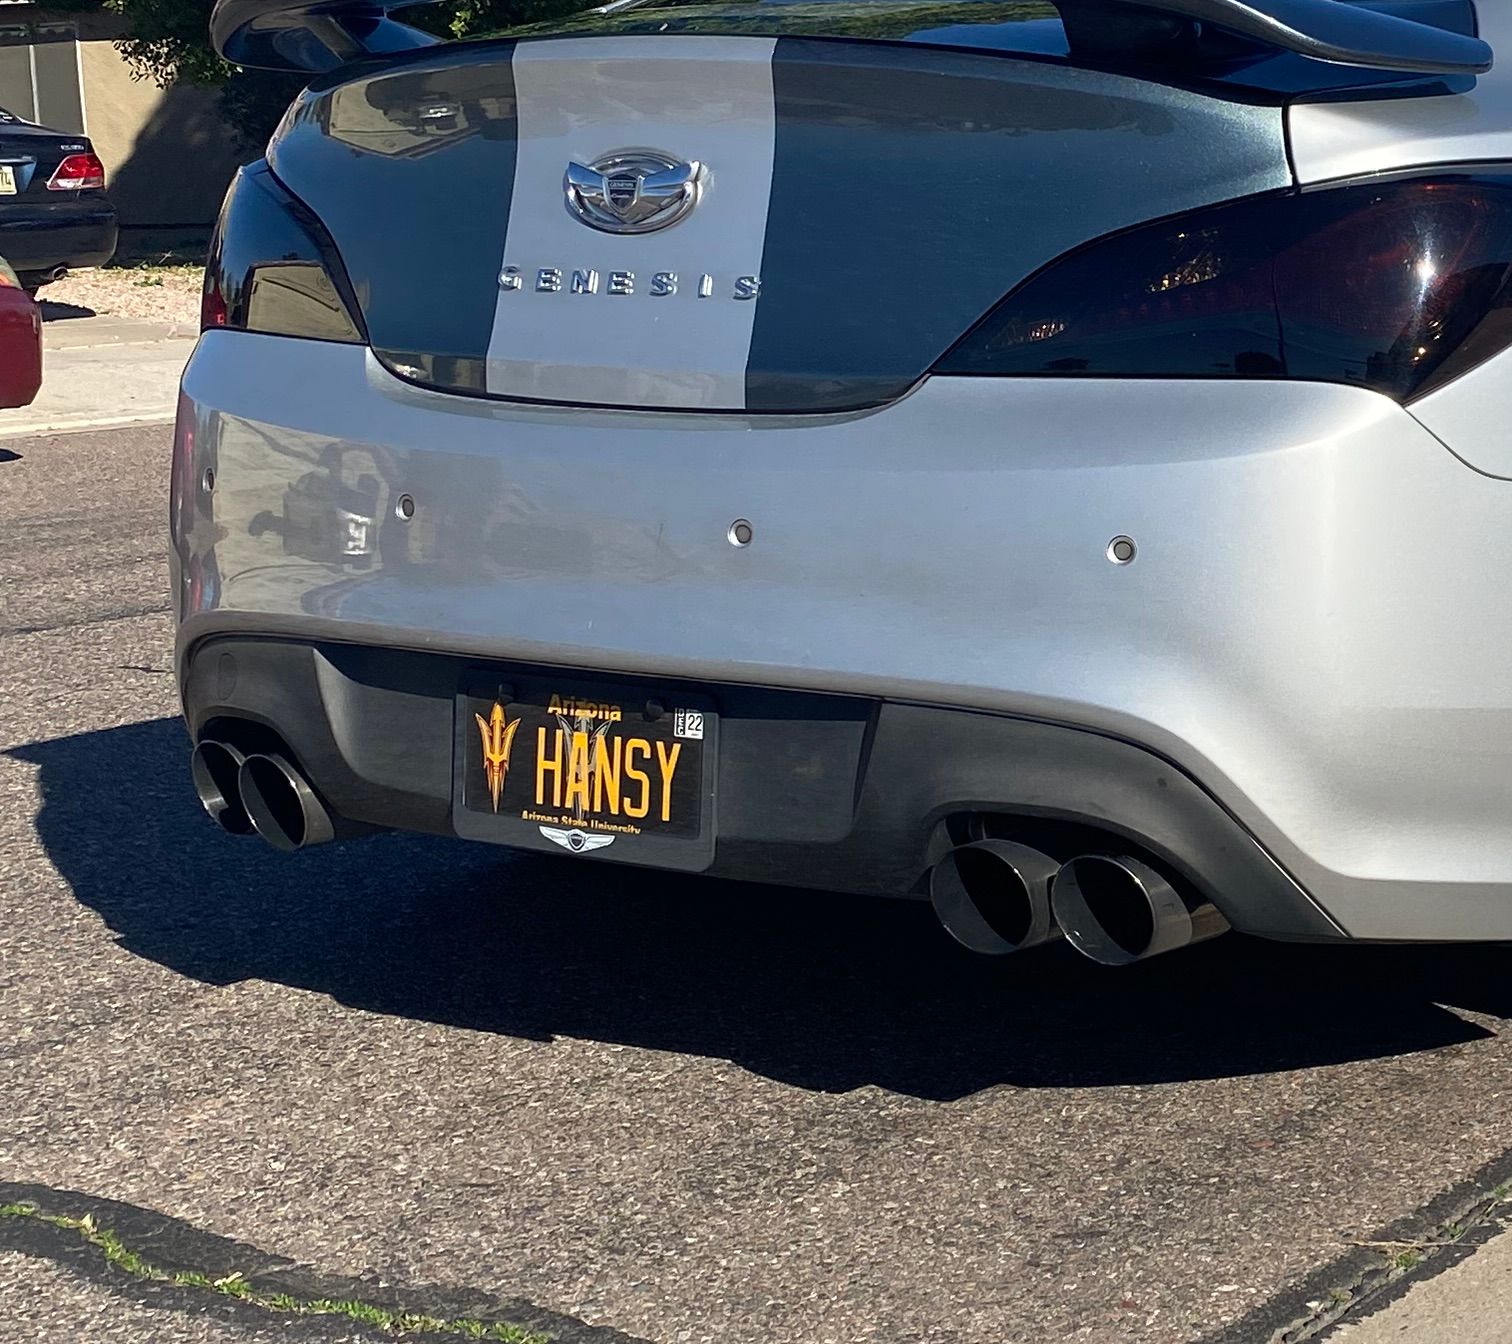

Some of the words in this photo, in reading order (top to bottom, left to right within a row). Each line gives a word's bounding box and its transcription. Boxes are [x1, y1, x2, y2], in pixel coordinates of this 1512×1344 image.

[498, 266, 762, 299] GENESIS
[547, 694, 622, 721] Arizona
[688, 714, 702, 732] 22
[536, 727, 681, 822] HANSY
[522, 810, 559, 824] Arizona
[561, 816, 588, 828] State
[590, 819, 641, 834] University
